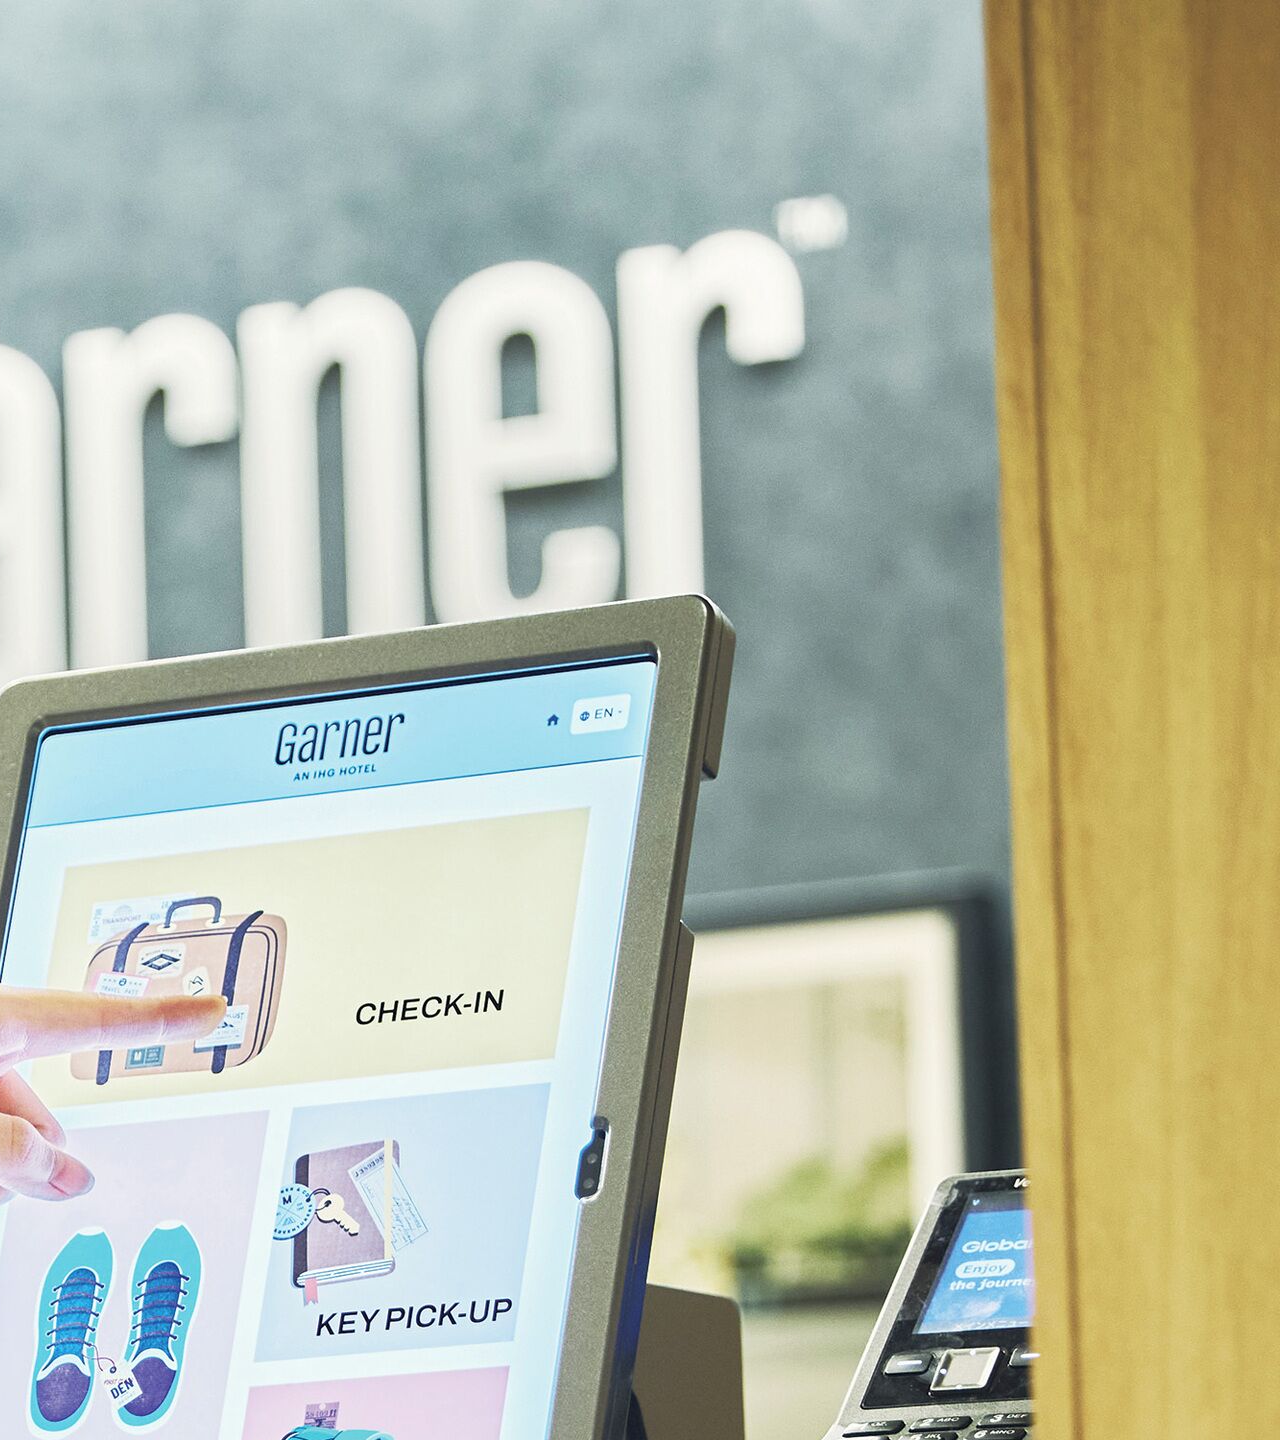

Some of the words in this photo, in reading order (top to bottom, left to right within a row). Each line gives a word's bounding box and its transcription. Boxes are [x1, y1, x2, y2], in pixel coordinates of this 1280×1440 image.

[594, 707, 614, 720] EN
[275, 712, 406, 766] Garner
[293, 772, 310, 781] AN
[313, 768, 335, 779] IHG
[339, 763, 377, 776] HOTEL
[355, 989, 505, 1026] CHECK-IN
[962, 1264, 1007, 1275] Enjoy
[949, 1280, 976, 1291] the
[977, 1278, 1034, 1292] journe
[315, 1308, 381, 1337] KEY
[384, 1297, 513, 1332] PICK-UP
[110, 1377, 135, 1400] DEN
[989, 1414, 1005, 1423] 3
[973, 1429, 988, 1439] 6
